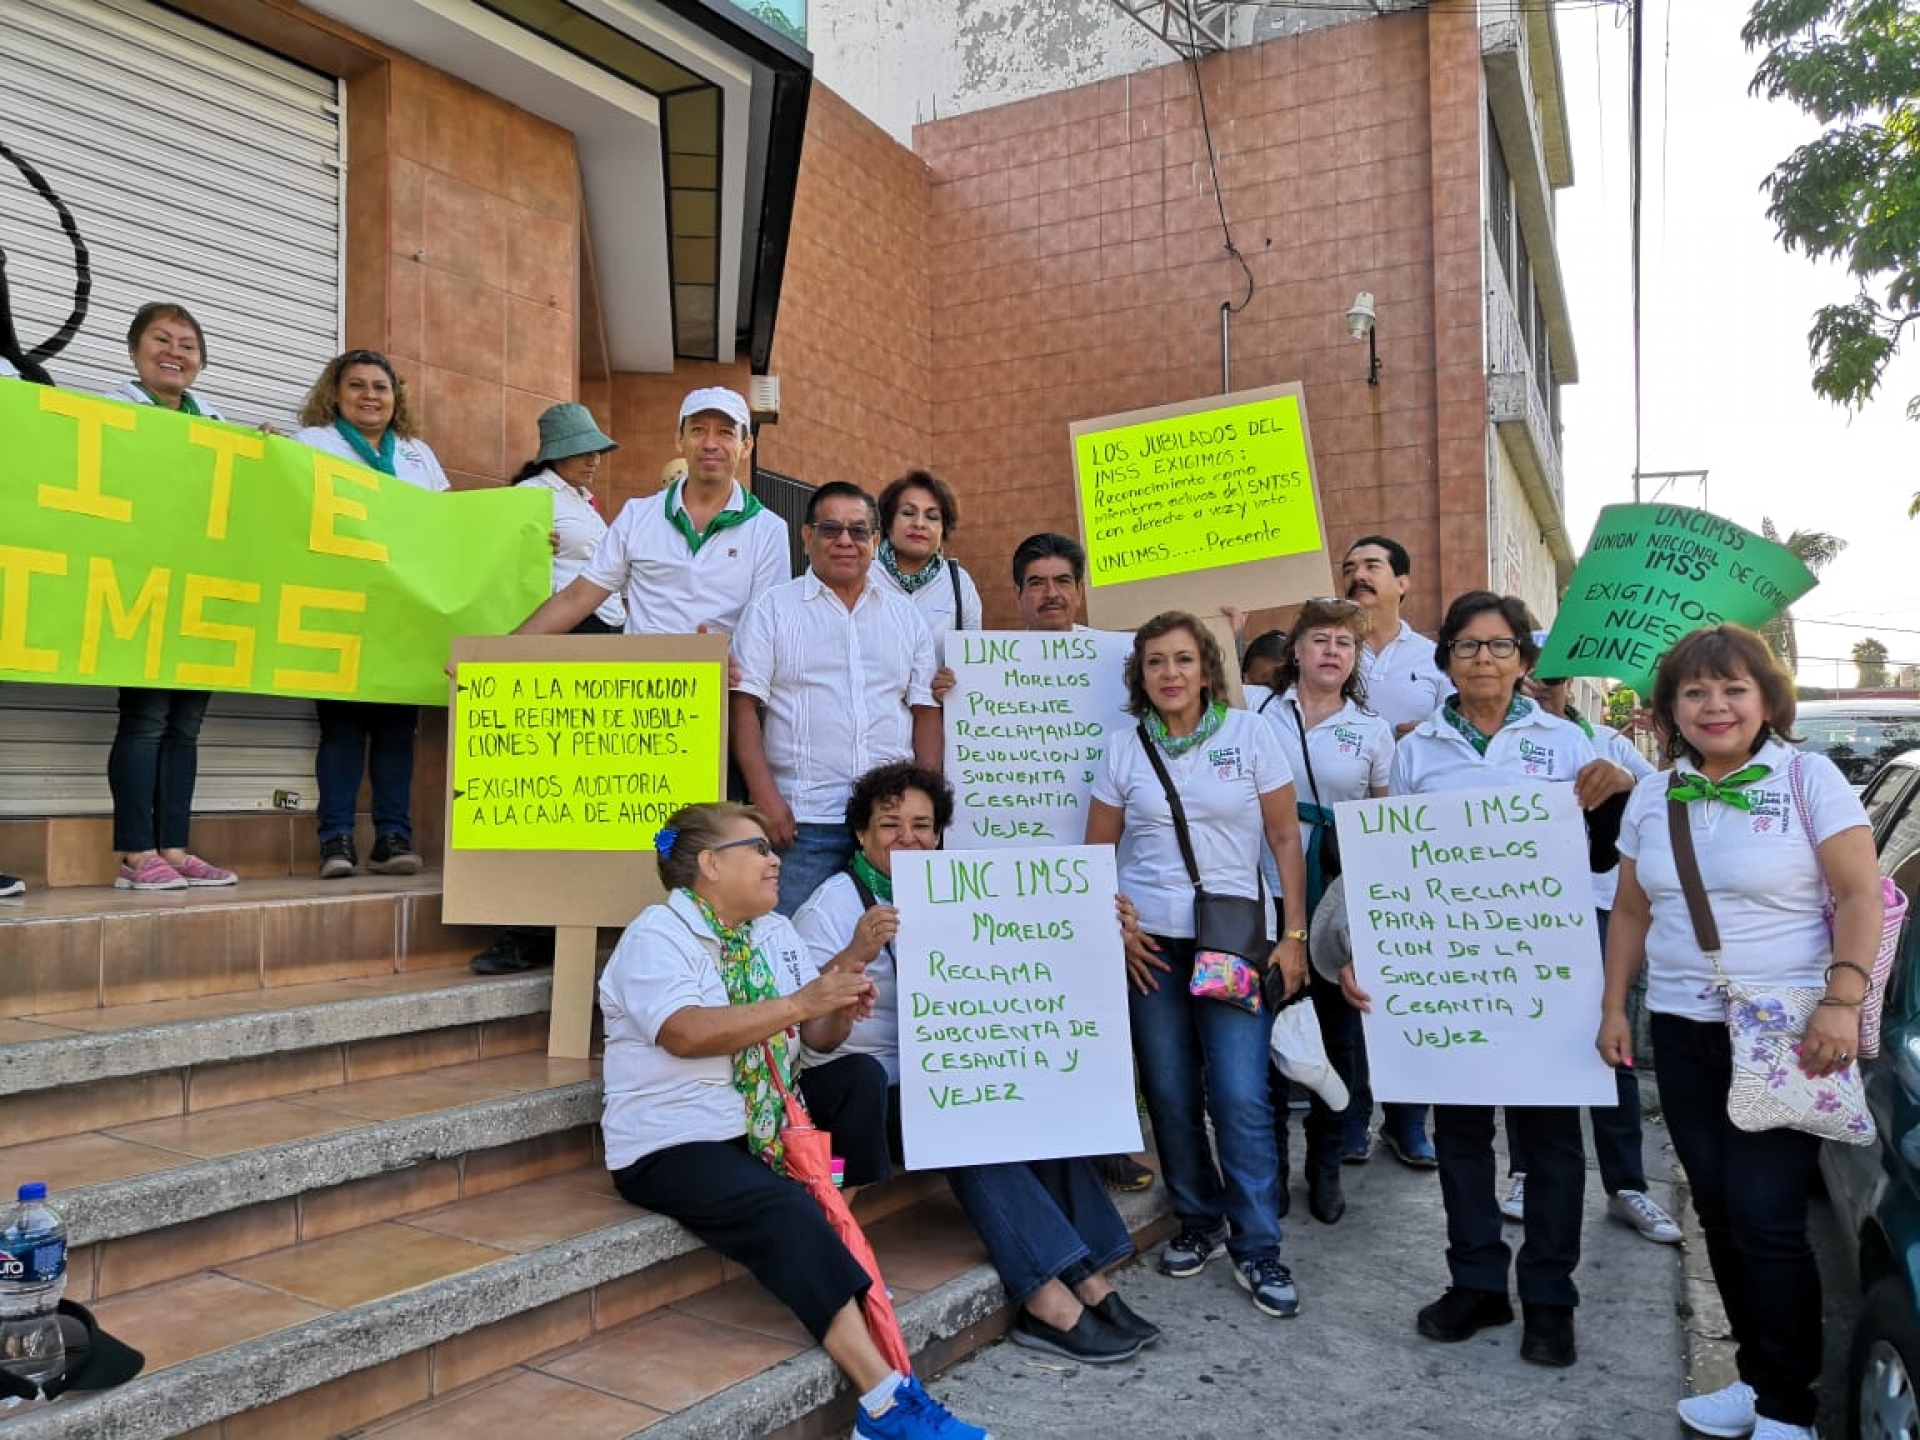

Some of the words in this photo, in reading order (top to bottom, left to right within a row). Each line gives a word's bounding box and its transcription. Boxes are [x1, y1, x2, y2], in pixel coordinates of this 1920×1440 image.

[1092, 442, 1130, 465] LOS
[1139, 424, 1238, 457] JUBILADOS
[1249, 418, 1284, 436] DEL
[37, 387, 390, 565] ITE
[1095, 463, 1141, 488] IMSS
[1222, 481, 1244, 498] del
[1249, 471, 1301, 494] SNTSS
[1096, 526, 1124, 541] con
[1206, 520, 1281, 550] Presente
[1655, 507, 1748, 551] UNCIMSS
[1594, 532, 1639, 551] UNION
[1646, 532, 1720, 567] NACIONAL
[1729, 561, 1756, 585] DE
[1645, 551, 1712, 582] IMSS
[1585, 582, 1725, 626] EXIGIMOS
[0, 544, 367, 694] IMSS
[964, 638, 1022, 665] UNC
[1041, 637, 1098, 661] IMSS
[469, 676, 497, 700] NO
[512, 679, 523, 699] A
[534, 677, 563, 700] LA
[574, 678, 698, 700] MODIFICACION
[967, 691, 1074, 716] PRESENTE
[469, 709, 507, 729] DEL
[514, 707, 596, 729] REGIMEN
[603, 709, 625, 729] DE
[631, 707, 700, 730] JUBILA-
[956, 719, 1103, 745] RECLAMANDO
[468, 732, 539, 758] CIONES
[547, 732, 562, 757] Y
[572, 731, 688, 756] PENCIONES.
[956, 744, 1080, 763] DEVOLUCION
[467, 775, 563, 801] EXIGIMOS
[573, 773, 671, 798] AUDITORIA
[472, 806, 486, 826] A
[494, 804, 518, 826] LA
[524, 802, 574, 825] CAJA
[584, 803, 611, 823] DE
[618, 802, 690, 825] AHORR
[972, 815, 1055, 839] VEJEZ
[1358, 804, 1437, 834] UNC
[1465, 793, 1550, 827] IMSS
[1411, 839, 1538, 869] MORELOS
[926, 859, 1000, 903] UNC
[1015, 859, 1090, 897] IMSS
[1369, 882, 1411, 902] EN
[1426, 876, 1563, 906] RECLAMO
[972, 912, 1075, 945] MORELOS
[1367, 909, 1437, 931] PARA
[1446, 911, 1480, 931] LA
[1377, 939, 1433, 957] CION
[1494, 939, 1534, 957] LA
[928, 950, 1053, 985] RECLAMA
[1380, 964, 1518, 986] SUBCUENTA
[1534, 964, 1572, 981] DE
[911, 992, 1066, 1018] DEVOLUCION
[915, 1020, 1061, 1042] SUBCUENTA
[1067, 1019, 1100, 1037] DE
[928, 1082, 1026, 1110] VEJEZ
